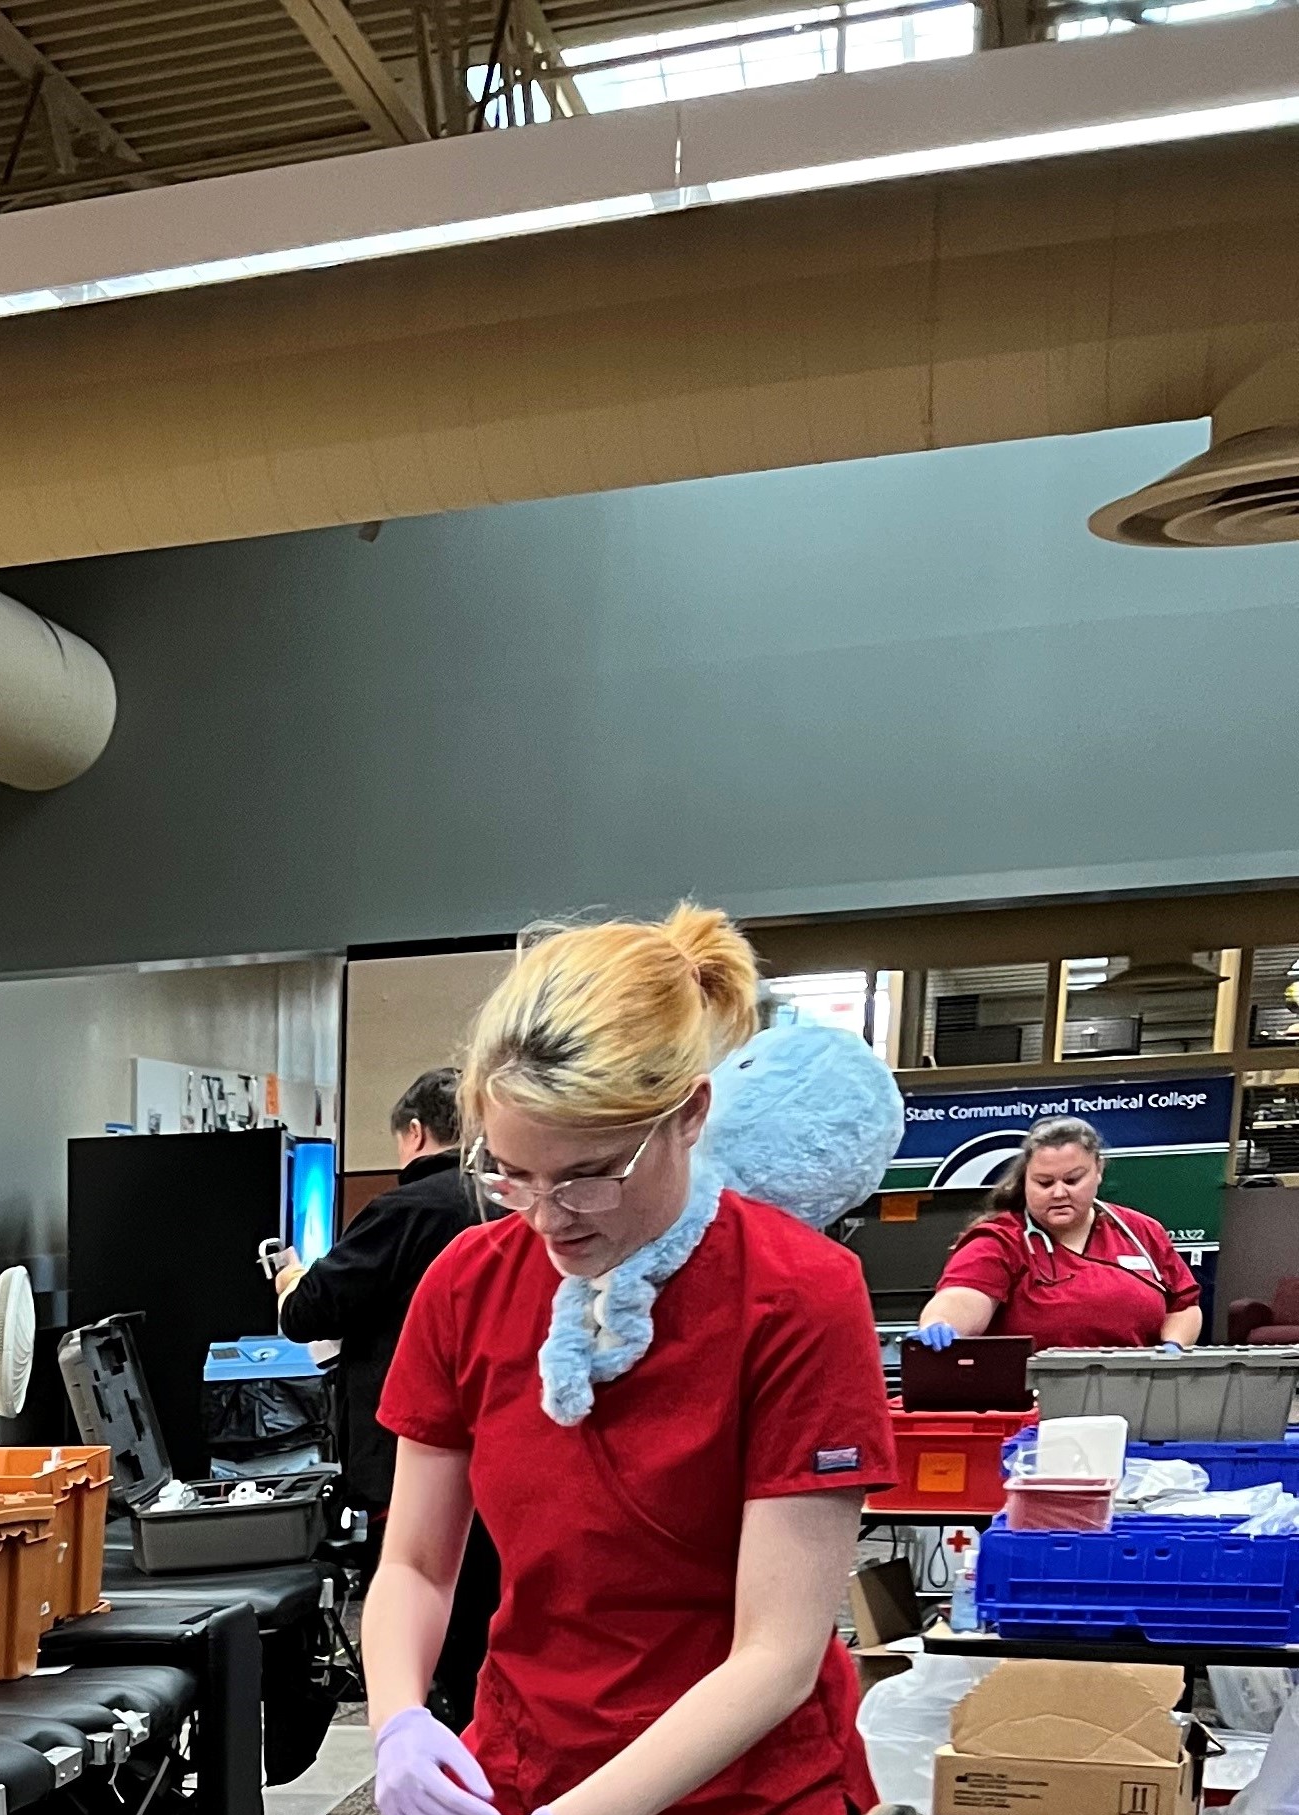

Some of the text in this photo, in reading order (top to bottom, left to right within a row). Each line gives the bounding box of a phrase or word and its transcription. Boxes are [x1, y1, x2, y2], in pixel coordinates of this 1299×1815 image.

[905, 1091, 1208, 1121] State Community and Technical College
